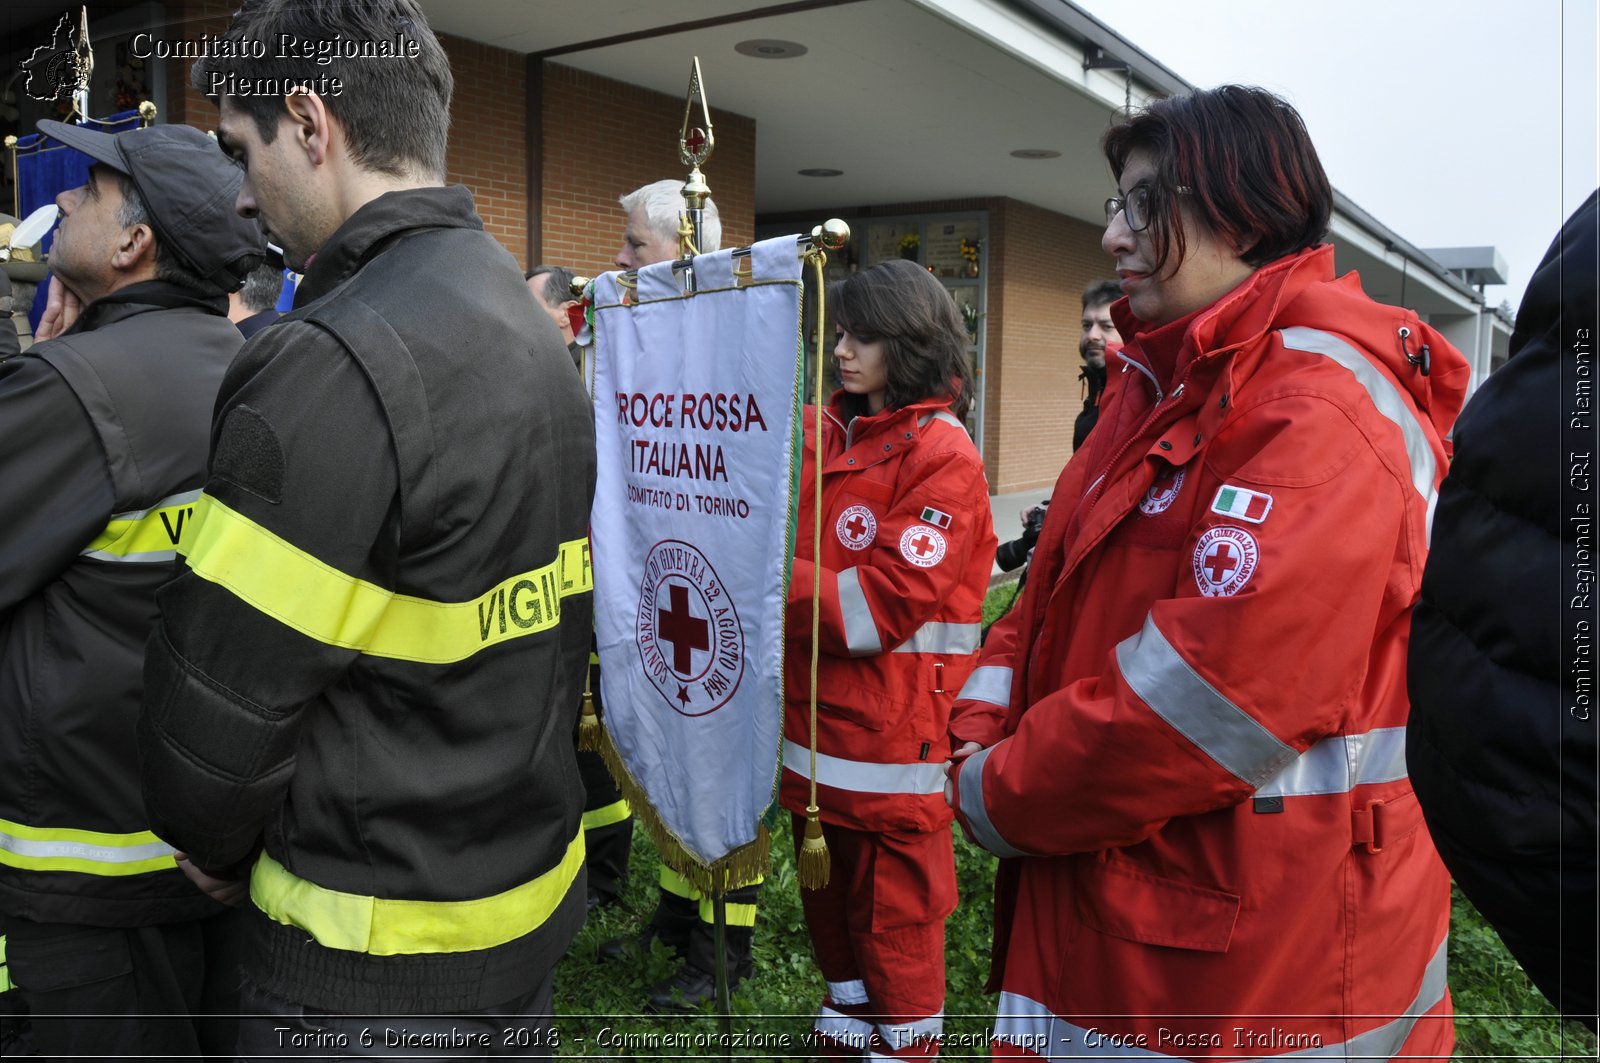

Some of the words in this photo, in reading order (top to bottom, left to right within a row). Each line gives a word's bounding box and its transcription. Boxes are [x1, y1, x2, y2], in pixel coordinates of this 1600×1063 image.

[681, 392, 768, 432] ROSSA
[631, 439, 729, 482] ITALIANA
[627, 484, 672, 510] COMITATO
[676, 493, 690, 512] DI
[696, 495, 750, 519] TORINO
[159, 507, 193, 546] V
[649, 557, 661, 582] DI
[659, 548, 706, 586] GINEVRA
[703, 579, 720, 604] 22
[640, 573, 668, 685] CONVENZIONE
[713, 607, 739, 672] AGOSTO
[701, 667, 732, 701] 1864
